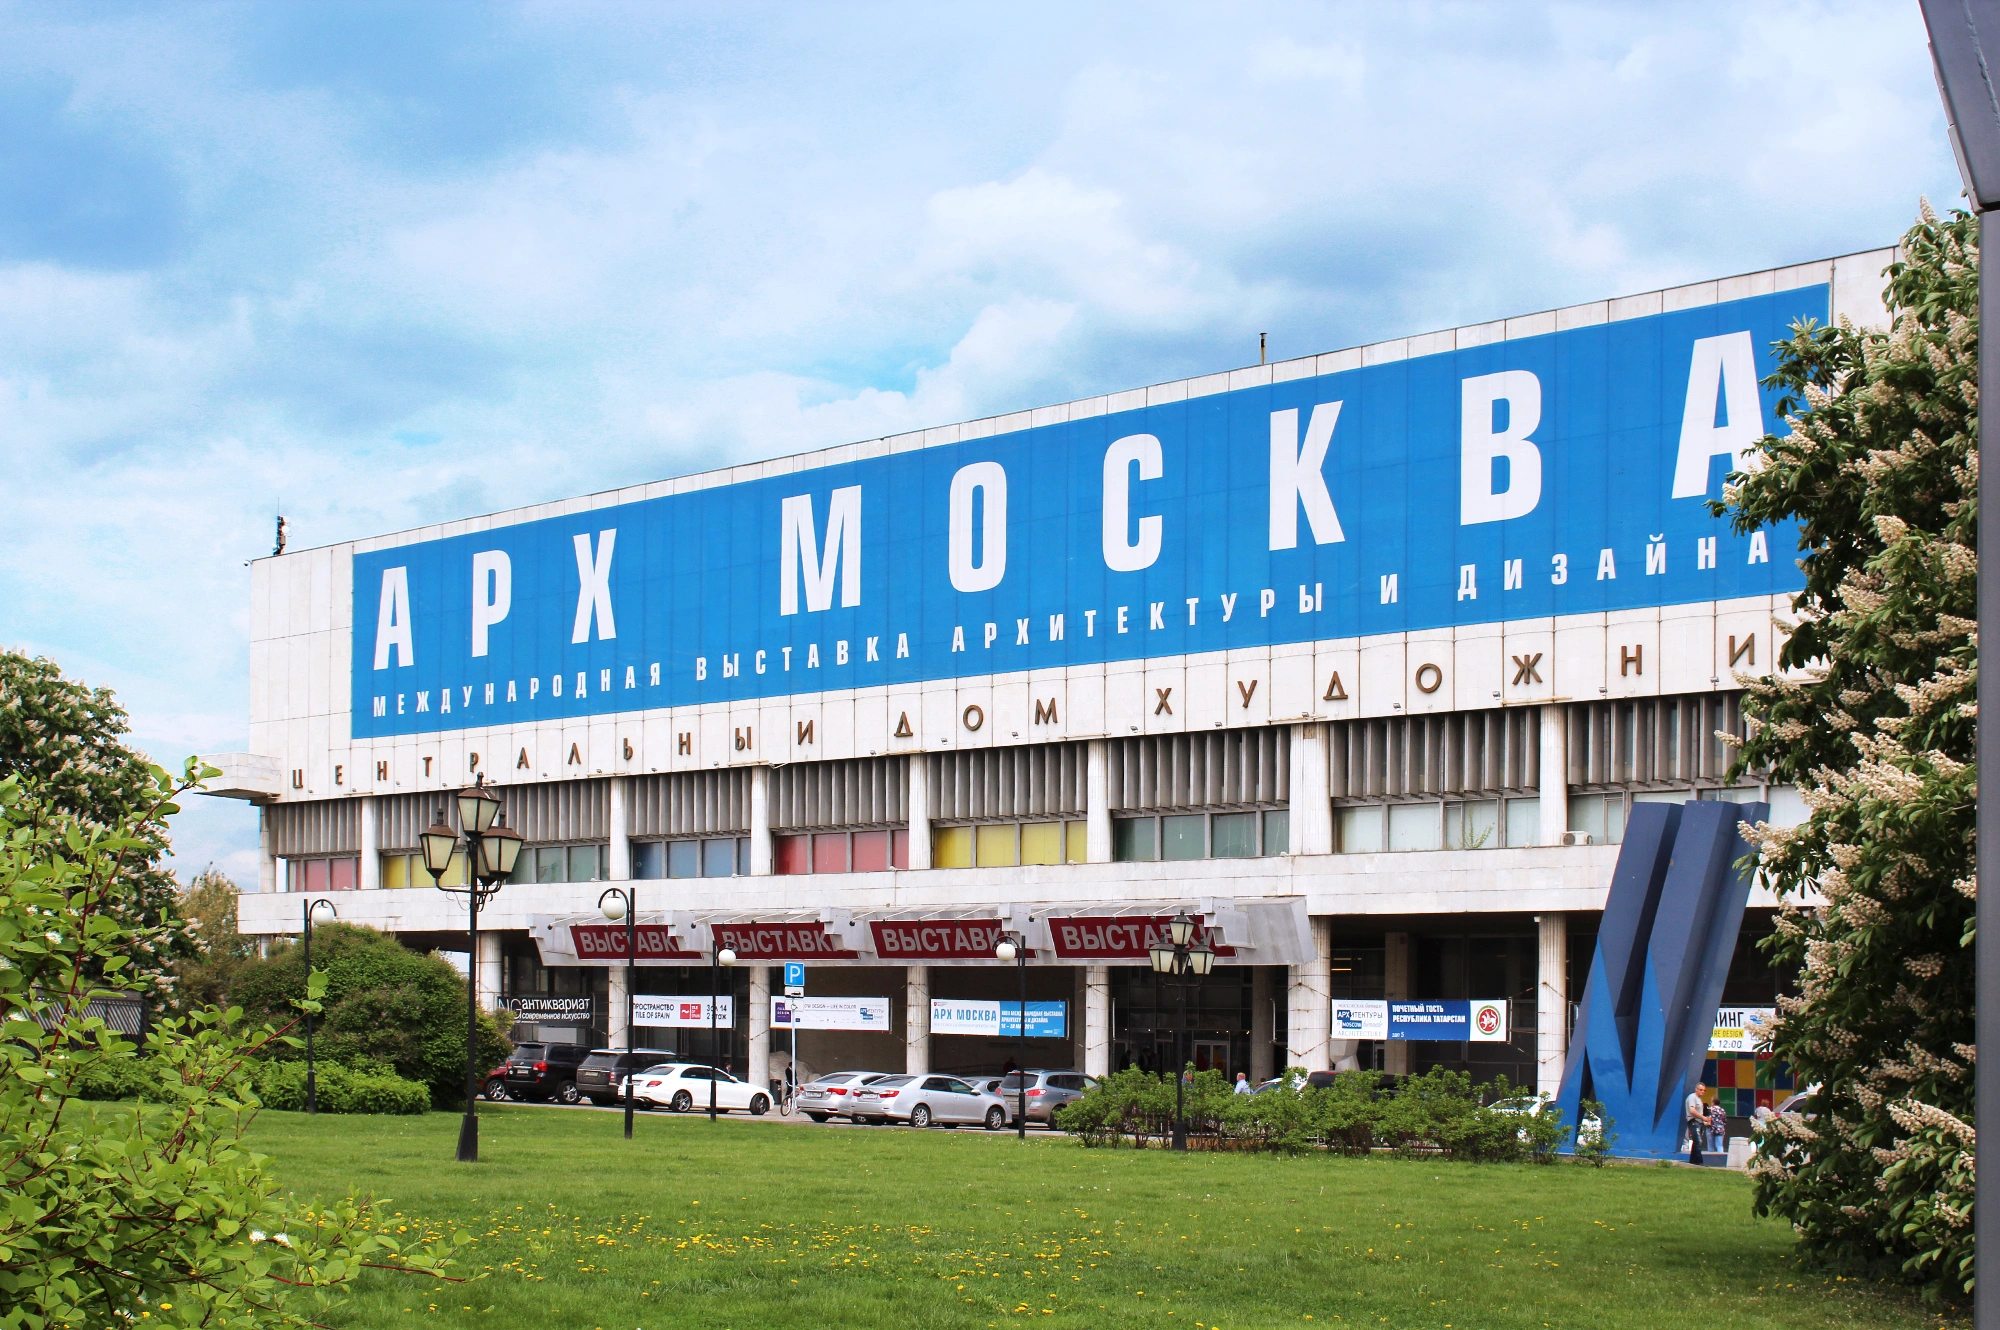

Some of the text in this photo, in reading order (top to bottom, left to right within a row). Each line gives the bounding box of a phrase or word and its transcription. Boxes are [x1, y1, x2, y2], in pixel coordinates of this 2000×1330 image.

[373, 330, 1767, 671] АРХ МОСКВА
[373, 530, 1769, 718] МЕЖДУНАРОДНАЯ ВЫСТАВКА АРХИТЕКТУРЫ И ДИЗАЙНА
[893, 697, 1059, 738] ДОМ
[721, 930, 847, 953] ВЫСТАВК
[521, 998, 590, 1013] антиквариат
[1392, 1003, 1444, 1013] ПОЧЕТНЫЙ ГОСТЬ
[933, 1008, 997, 1021] АРХ МОСКВА
[1337, 1010, 1383, 1018] АРХИТЕКТУРЫ
[1392, 1014, 1466, 1023] РЕСПУБЛИКА ТАТАРСТАН
[1722, 1029, 1744, 1038] DESIGN
[1718, 1039, 1743, 1049] 12:00
